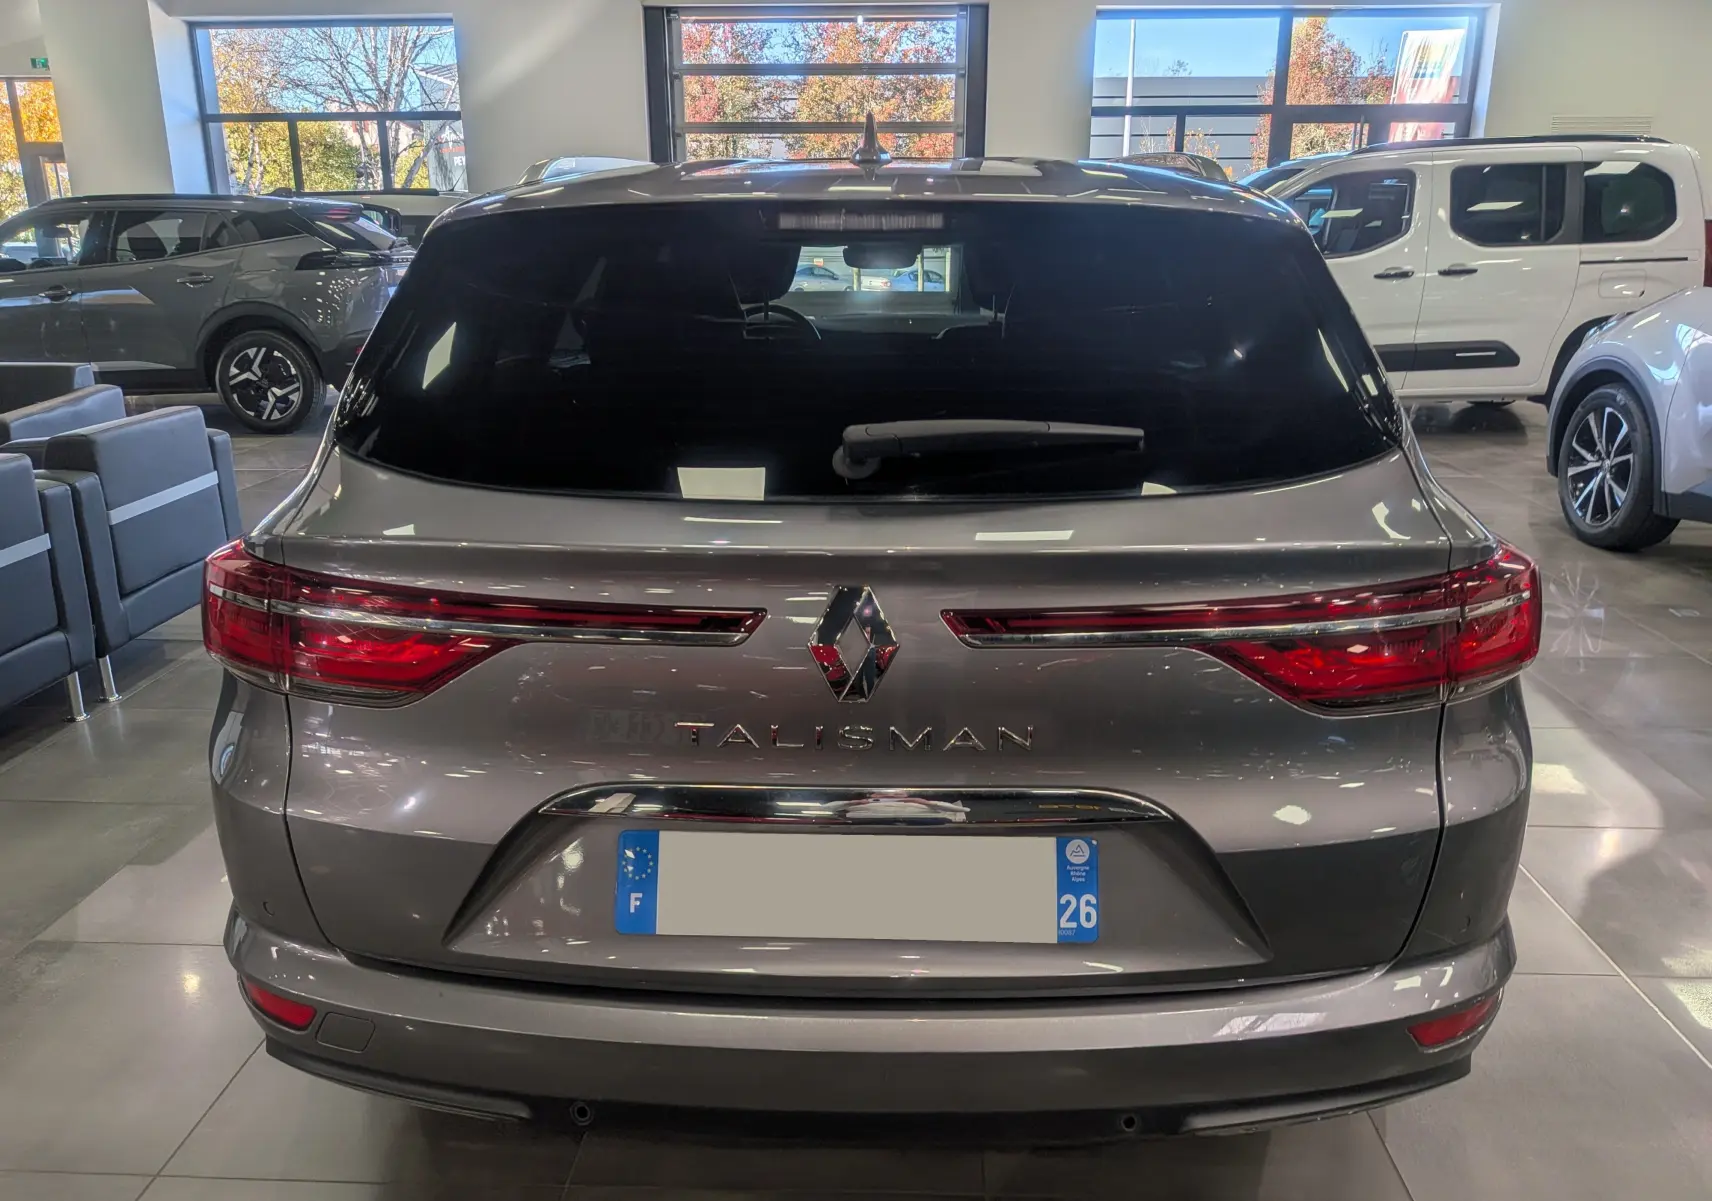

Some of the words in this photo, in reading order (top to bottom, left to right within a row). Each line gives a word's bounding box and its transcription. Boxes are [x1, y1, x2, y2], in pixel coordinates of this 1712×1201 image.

[674, 722, 1033, 751] TALISMAN
[629, 893, 643, 913] F
[1060, 894, 1097, 928] 26
